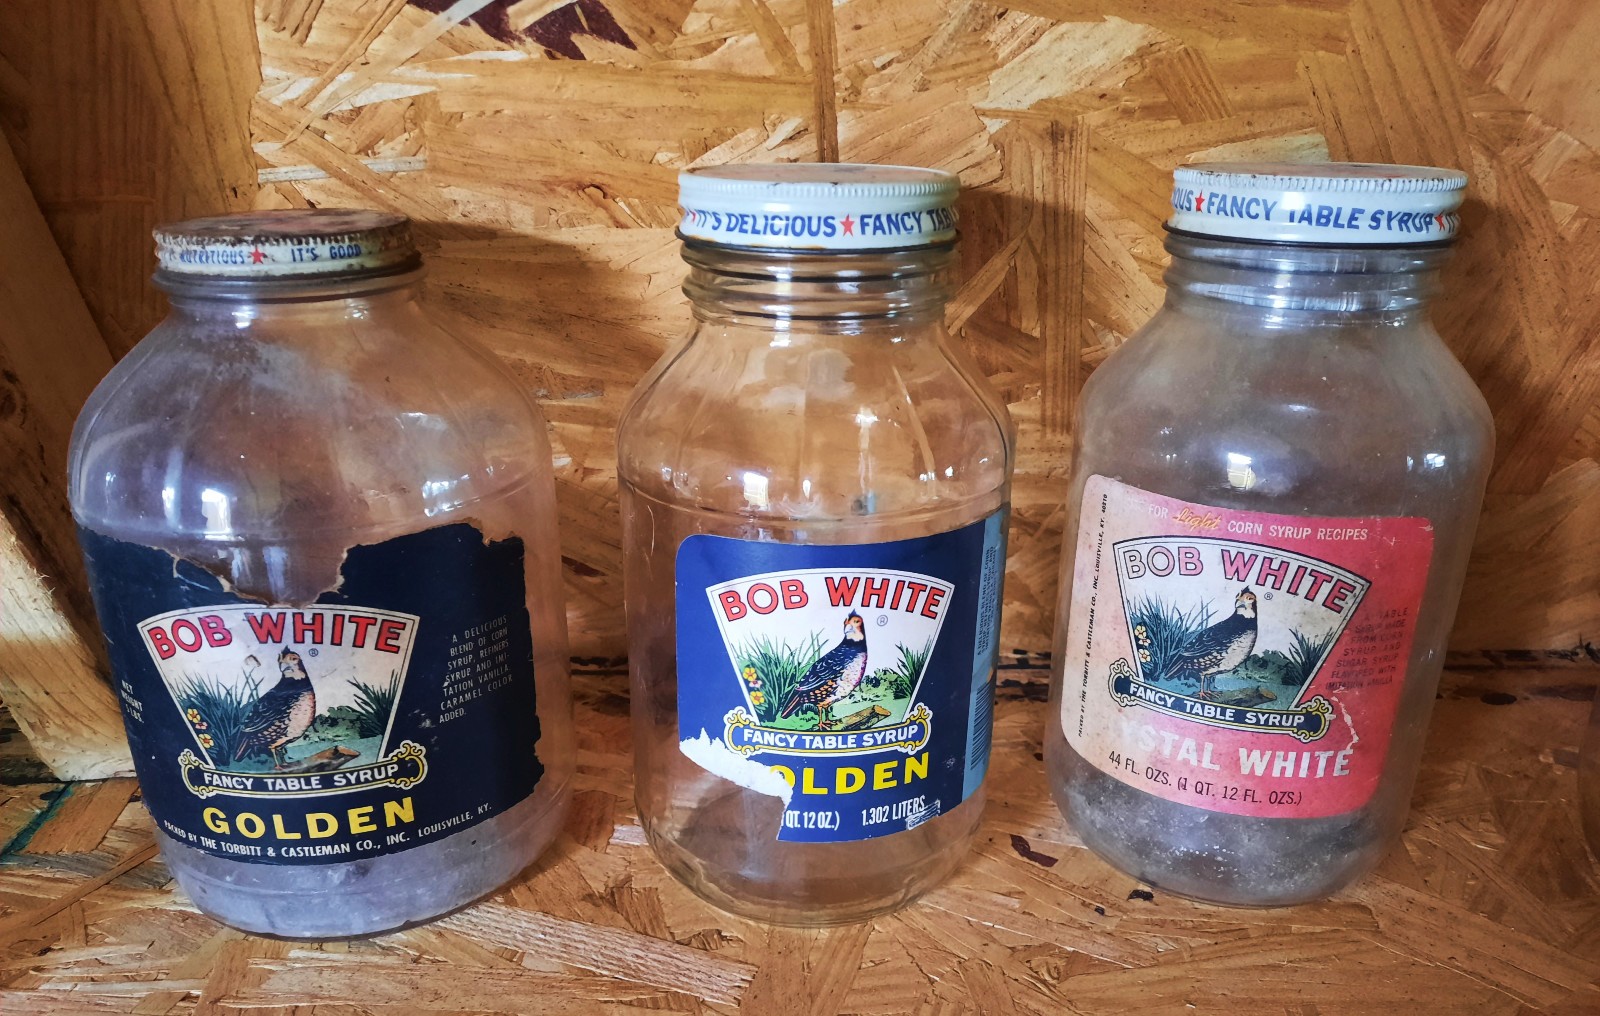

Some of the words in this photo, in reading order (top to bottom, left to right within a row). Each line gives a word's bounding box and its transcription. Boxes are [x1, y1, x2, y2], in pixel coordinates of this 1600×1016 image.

[694, 208, 722, 231] IT'S
[725, 212, 837, 238] DELICIOUS
[859, 211, 924, 236] FANCY
[1207, 192, 1278, 220] FANCY
[1288, 204, 1366, 230] TABLE
[1368, 208, 1434, 233] SYRUP
[180, 249, 245, 264] NUTRITIOUS
[291, 247, 318, 263] IT'S
[329, 244, 362, 260] GOOD
[1148, 504, 1169, 519] FOR
[1172, 506, 1222, 531] Light
[1227, 520, 1263, 536] CORN
[1269, 525, 1312, 540] SYRUP
[1317, 527, 1369, 541] RECIPES
[1124, 546, 1203, 580] BOB
[1221, 549, 1356, 613] WHITE
[718, 579, 809, 623] BOB
[824, 577, 946, 620] WHITE
[147, 614, 233, 660] BOB
[248, 611, 407, 653] WHITE
[450, 641, 474, 656] BLEND
[491, 627, 508, 641] CORN
[452, 634, 458, 643] A
[464, 614, 507, 639] DELICIOUS
[1085, 608, 1095, 650] CASTLEMAN
[479, 639, 509, 659] REFINERS
[445, 667, 471, 684] SYRUP
[476, 660, 492, 673] AND
[1082, 659, 1090, 688] TORBITT
[440, 688, 482, 711] CARAMEL
[487, 674, 513, 692] COLOR
[443, 679, 474, 697] TATION
[439, 707, 467, 724] ADDED.
[1129, 682, 1175, 709] FANCY
[1184, 699, 1235, 722] TABLE
[1245, 710, 1306, 727] SYRUP
[743, 728, 797, 750] FANCY
[802, 731, 857, 749] TABLE
[863, 724, 919, 748] SYRUP
[203, 771, 254, 790] FANCY
[263, 774, 322, 791] TABLE
[334, 763, 399, 785] SYRUP
[770, 752, 930, 795] OLDEN
[1108, 750, 1121, 766] 44
[1125, 757, 1140, 775] FL.
[1145, 766, 1172, 787] OZS.
[1194, 781, 1215, 797] QT.
[1222, 785, 1238, 800] 12
[1243, 788, 1262, 803] FL.
[1269, 790, 1302, 806] OZS.)
[1239, 748, 1354, 778] WHITE
[163, 819, 187, 838] PACKED
[187, 832, 198, 843] BY
[200, 836, 217, 849] THE
[220, 841, 261, 857] TORBITT
[267, 847, 276, 857] &
[281, 842, 351, 858] CASTLEMAN
[355, 840, 381, 851] CO.,
[386, 831, 410, 846] INC.
[418, 811, 474, 838] LOUISVILLE,
[477, 802, 492, 815] KY.
[202, 797, 415, 840] GOLDEN
[803, 810, 816, 828] 12
[818, 810, 840, 831] OZ.)
[861, 805, 889, 826] 1.302
